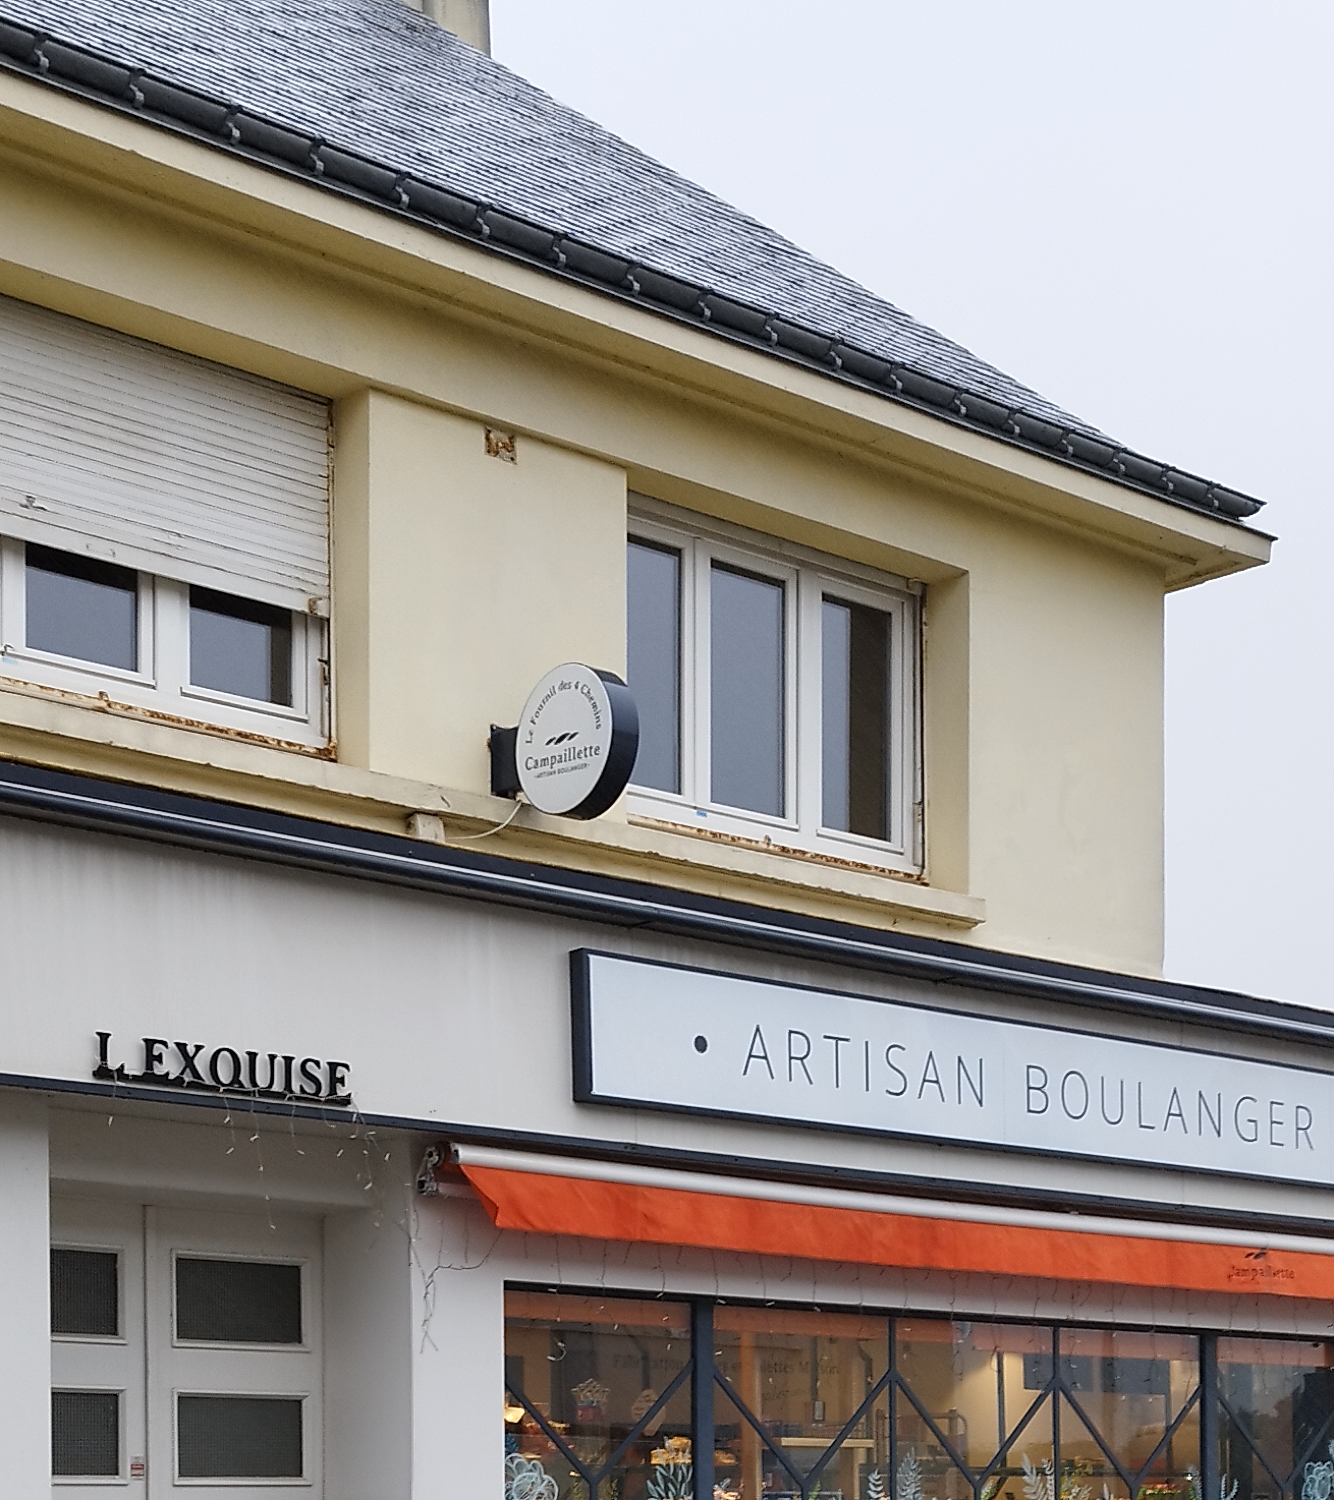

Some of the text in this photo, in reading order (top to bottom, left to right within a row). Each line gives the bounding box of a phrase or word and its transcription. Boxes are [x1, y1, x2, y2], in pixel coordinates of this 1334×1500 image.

[525, 744, 601, 771] Campaillette
[742, 1023, 985, 1108] ARTISAN
[1025, 1064, 1315, 1152] BOULANGER
